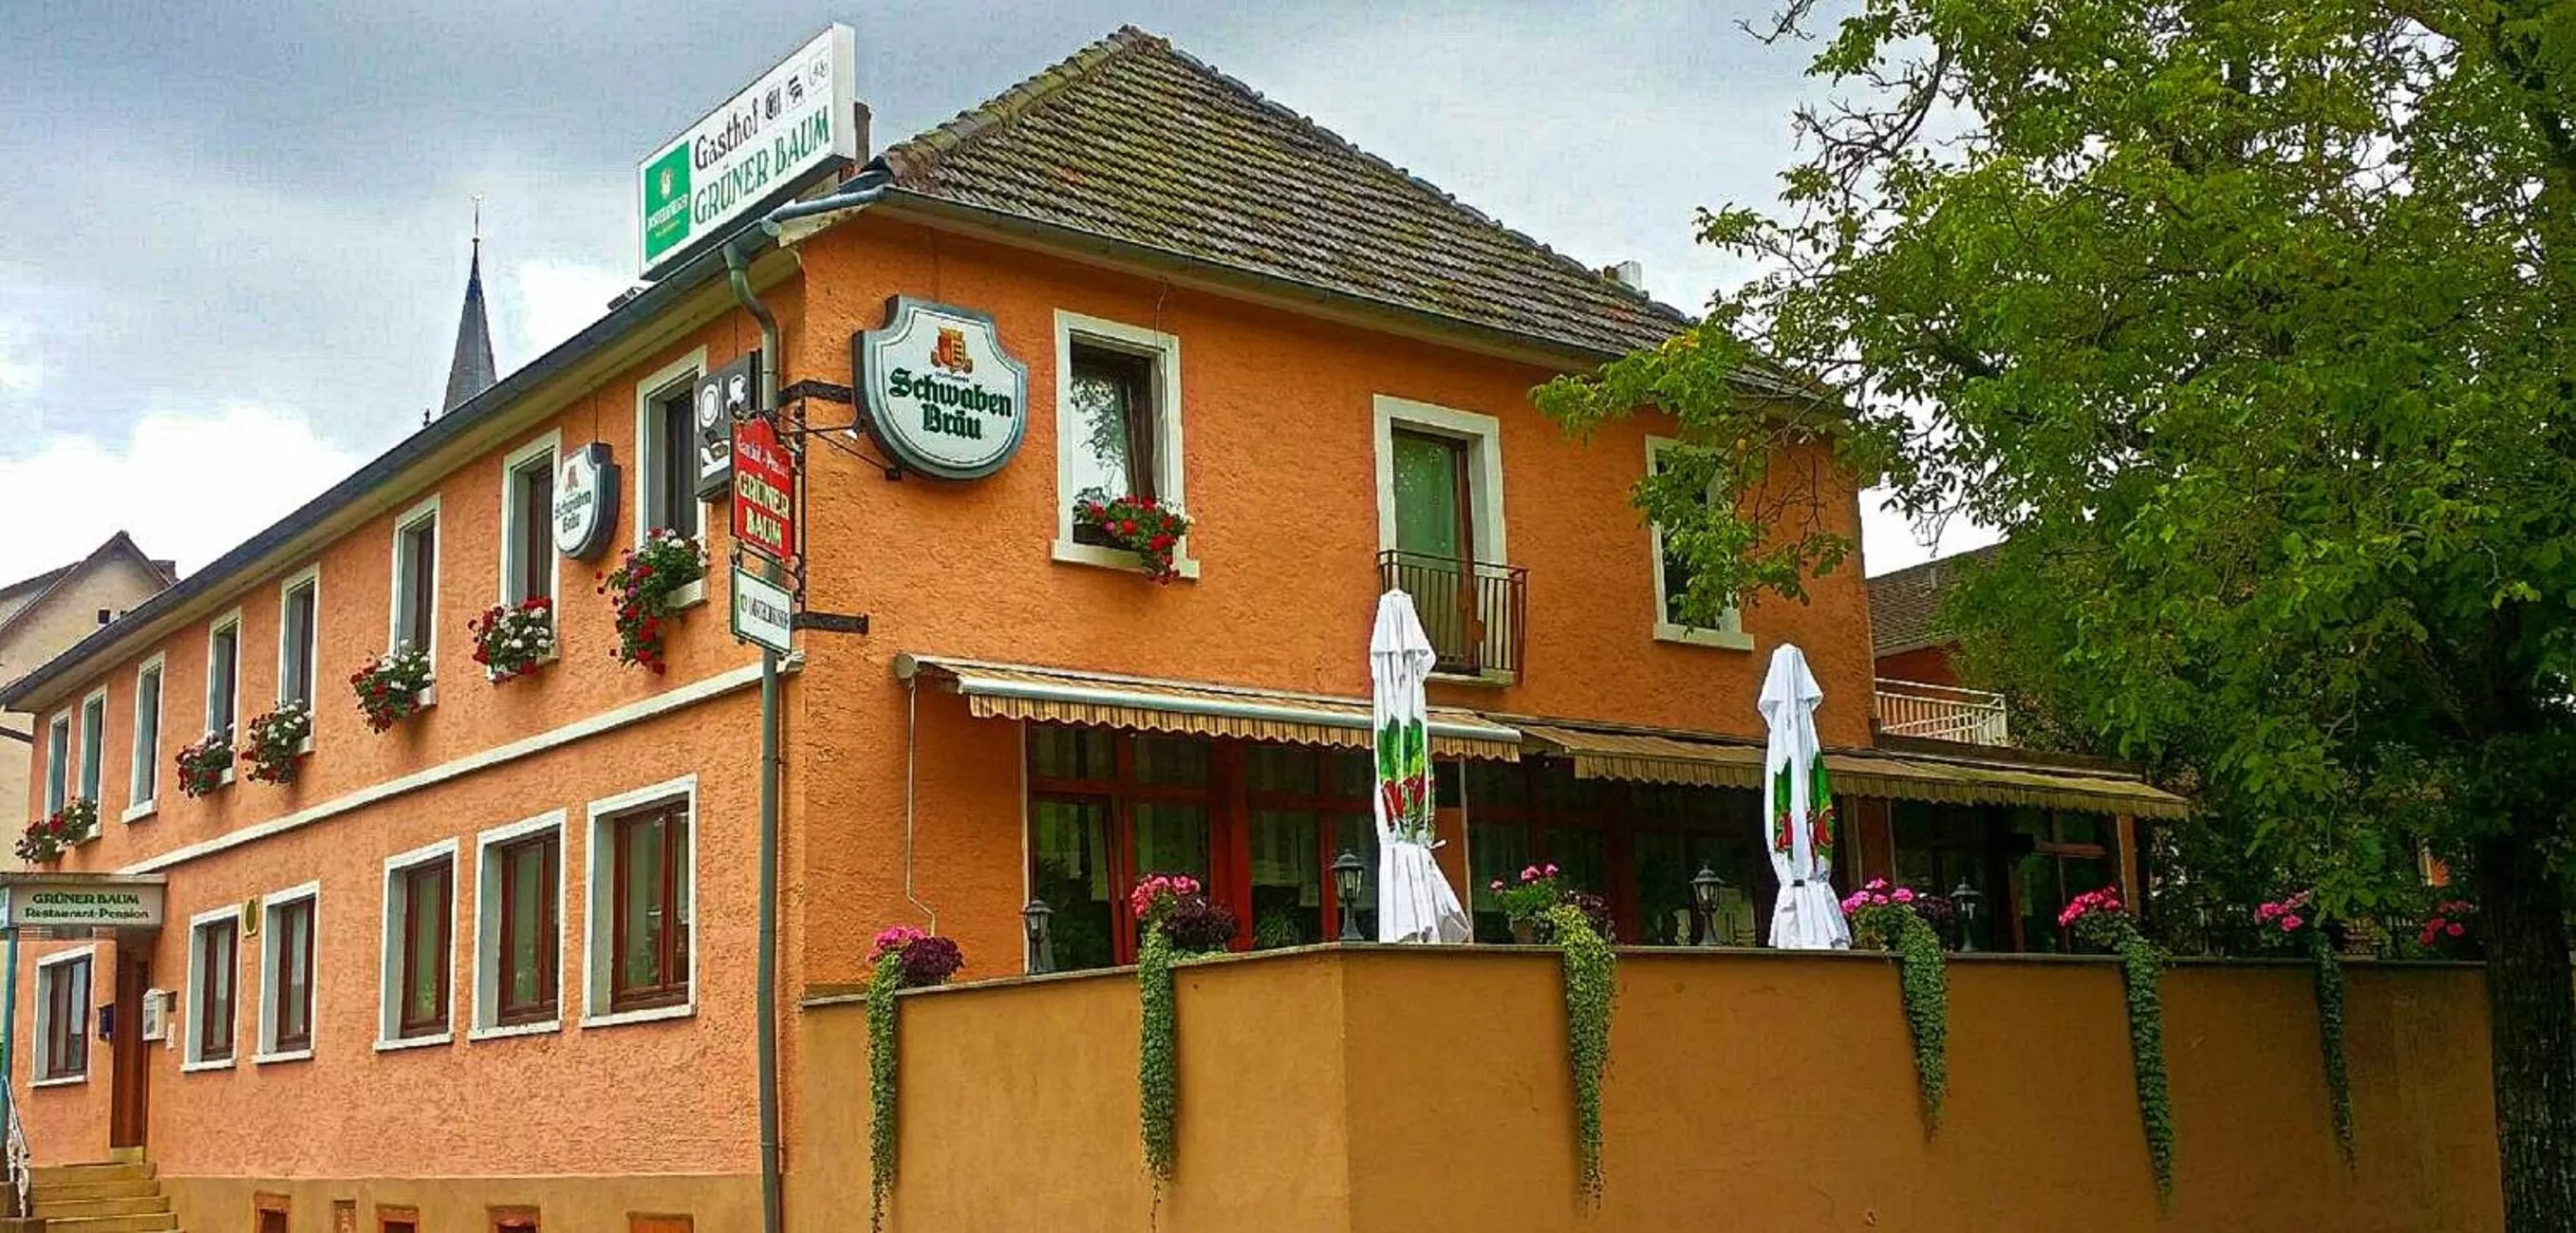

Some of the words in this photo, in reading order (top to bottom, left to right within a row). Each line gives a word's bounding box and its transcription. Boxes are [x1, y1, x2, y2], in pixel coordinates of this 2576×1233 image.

[694, 97, 758, 171] Gasthof
[694, 149, 770, 225] GRÜNER
[775, 105, 831, 177] BAUM
[888, 367, 1013, 418] Schwaben
[921, 402, 981, 439] Bräu
[737, 470, 790, 520] GRÜNER
[745, 506, 782, 550] BAUM
[31, 892, 95, 905] GRÜNER
[97, 893, 140, 905] BAUM
